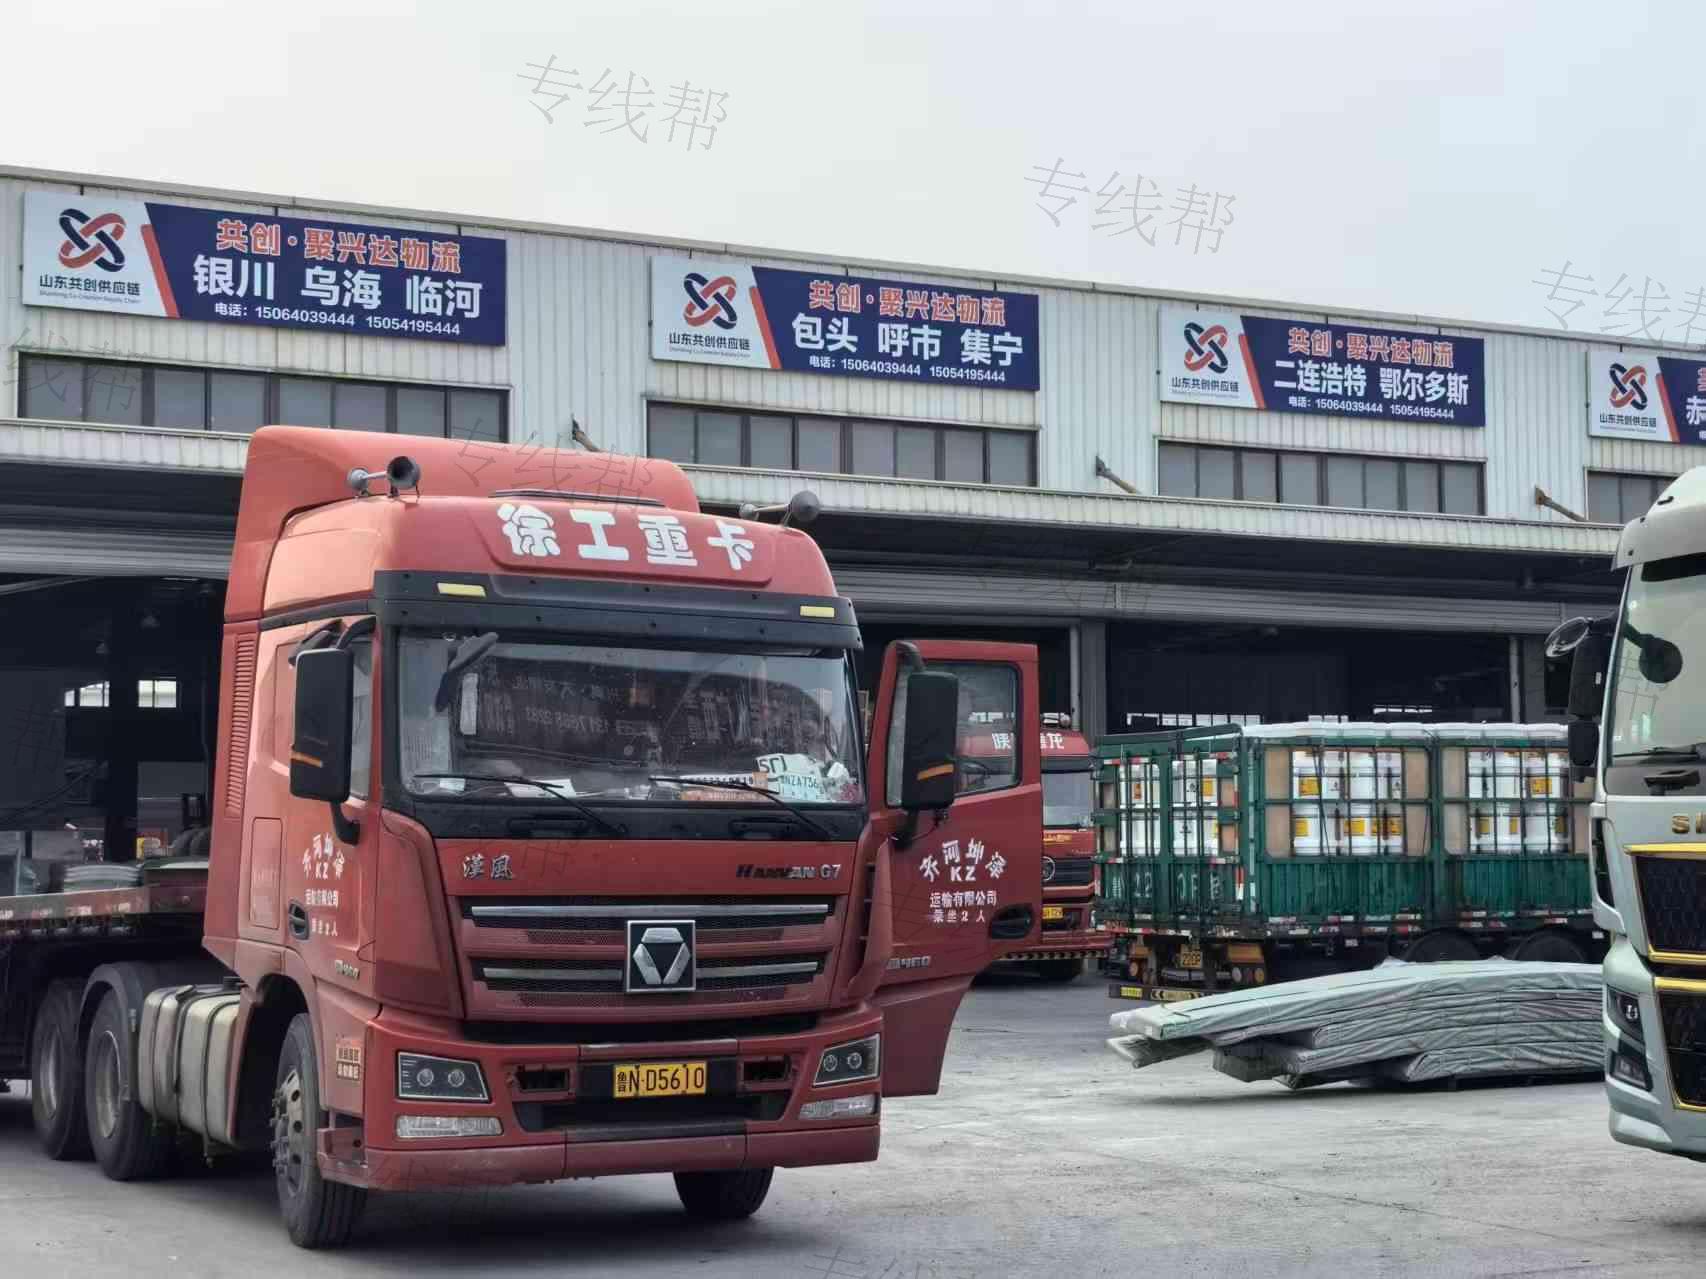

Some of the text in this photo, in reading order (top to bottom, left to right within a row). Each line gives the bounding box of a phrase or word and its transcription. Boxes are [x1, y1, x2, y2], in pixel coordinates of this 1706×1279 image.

[215, 218, 462, 274] 共创·聚兴达物流
[39, 273, 141, 297] 山东共创供应链
[192, 254, 483, 319] 银川 乌海 临河
[808, 279, 1007, 327] 共创·聚兴达物流
[365, 314, 461, 336] 15054195444
[668, 331, 751, 351] 山东共创供应链
[791, 312, 1023, 367] 包头 呼市 集宁
[1287, 327, 1454, 369] 共创·聚兴达物流
[929, 365, 1007, 383] 15054195444
[1171, 376, 1239, 393] 山东共创供应链
[1273, 359, 1469, 405] 二连浩特 鄂尔多斯
[496, 502, 755, 571] 徐工重卡
[461, 854, 513, 881] 漢風
[820, 862, 843, 880] G7
[929, 889, 998, 909] 运输有限公司
